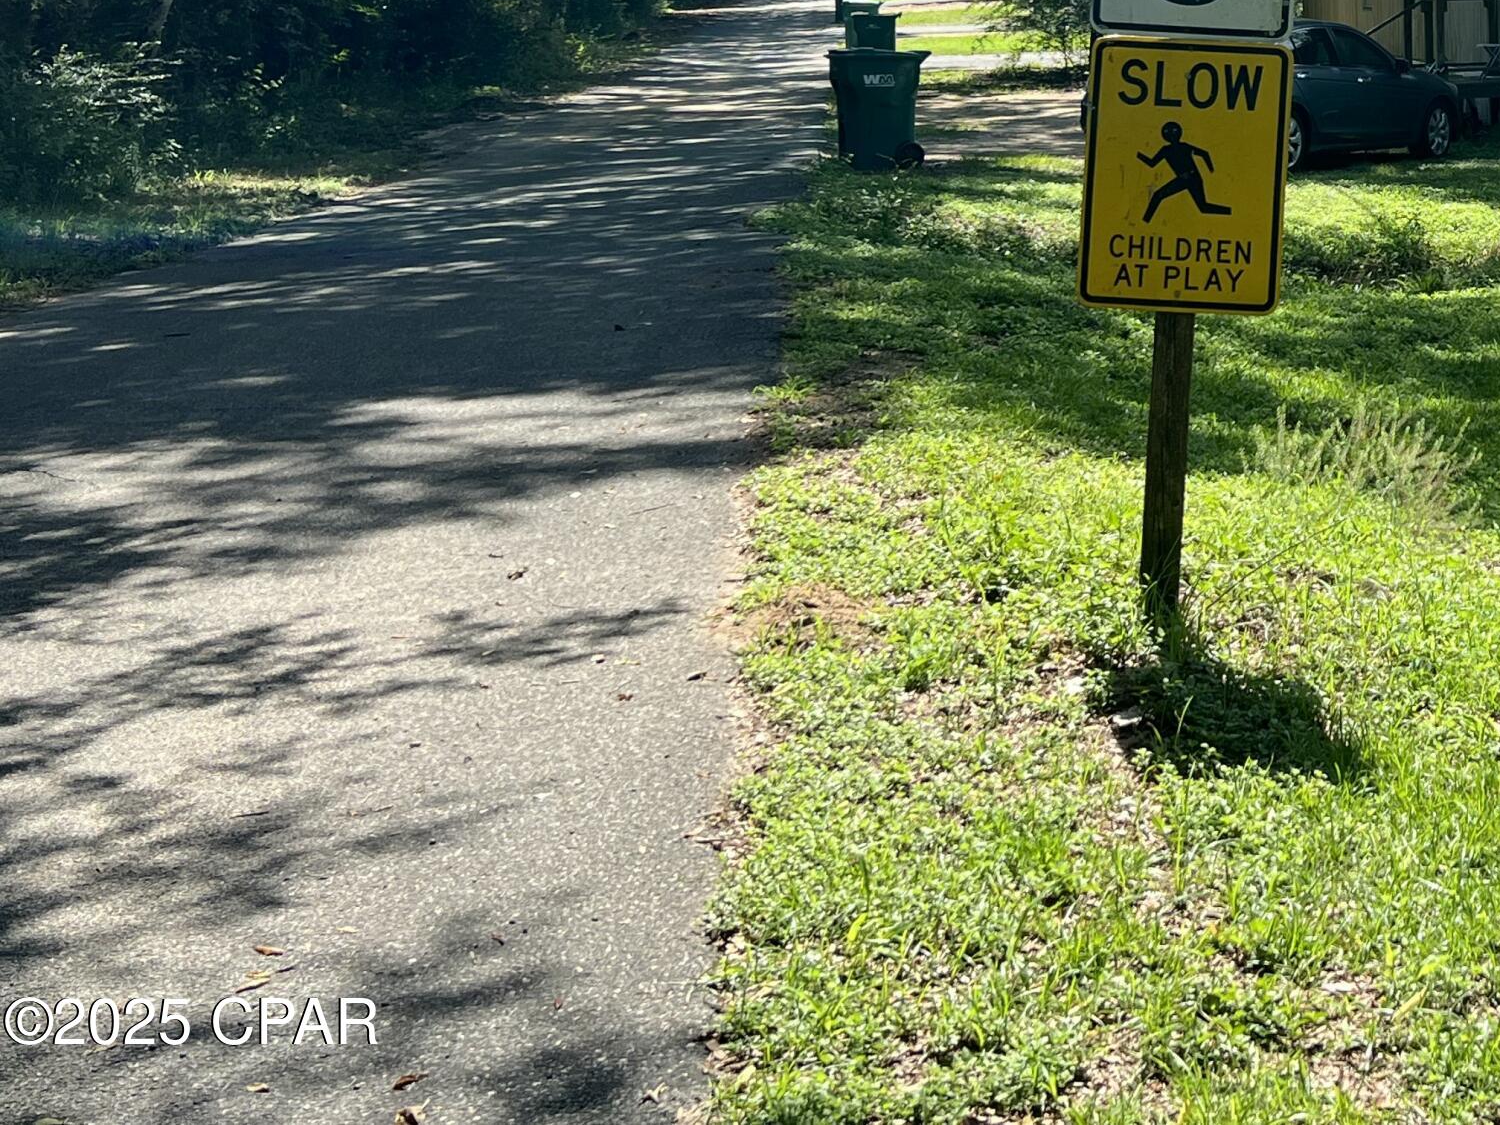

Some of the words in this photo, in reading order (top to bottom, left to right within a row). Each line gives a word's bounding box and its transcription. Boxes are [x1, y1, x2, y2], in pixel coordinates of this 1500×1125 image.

[1118, 58, 1263, 111] SLOW
[1109, 234, 1251, 265] CHILDREN
[1113, 264, 1148, 288] AT
[1163, 266, 1245, 293] PLAY
